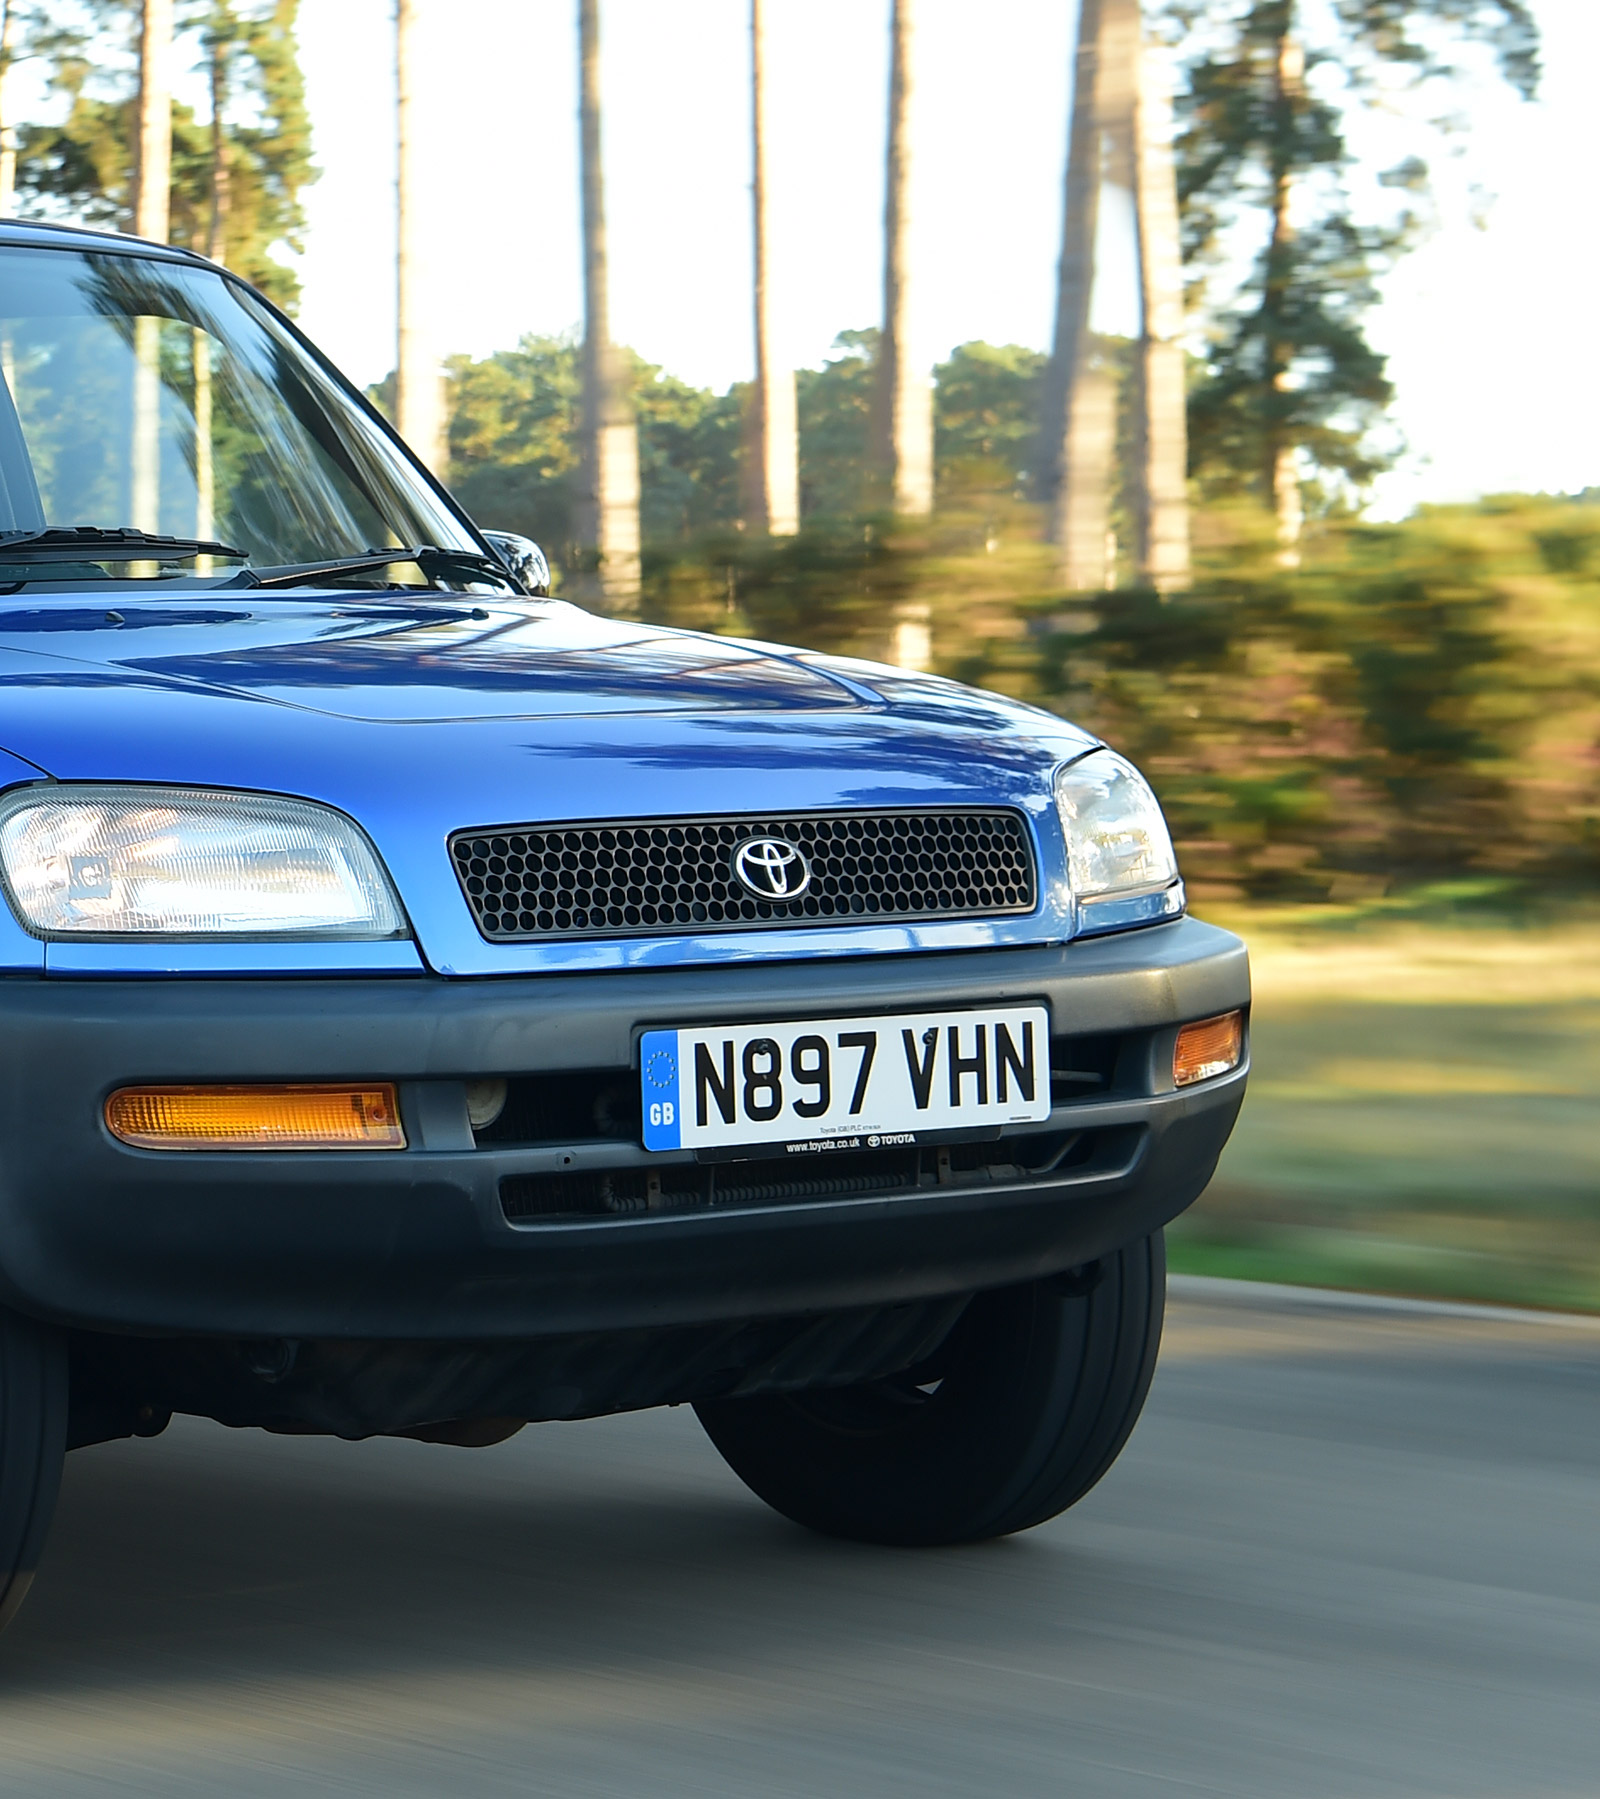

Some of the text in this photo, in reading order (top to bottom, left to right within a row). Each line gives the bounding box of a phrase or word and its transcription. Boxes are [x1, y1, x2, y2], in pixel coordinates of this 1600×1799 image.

[694, 1021, 1035, 1127] N897 VHN
[649, 1101, 675, 1126] GB
[786, 1133, 916, 1153] www.toyota.co.uk TOYOTA
